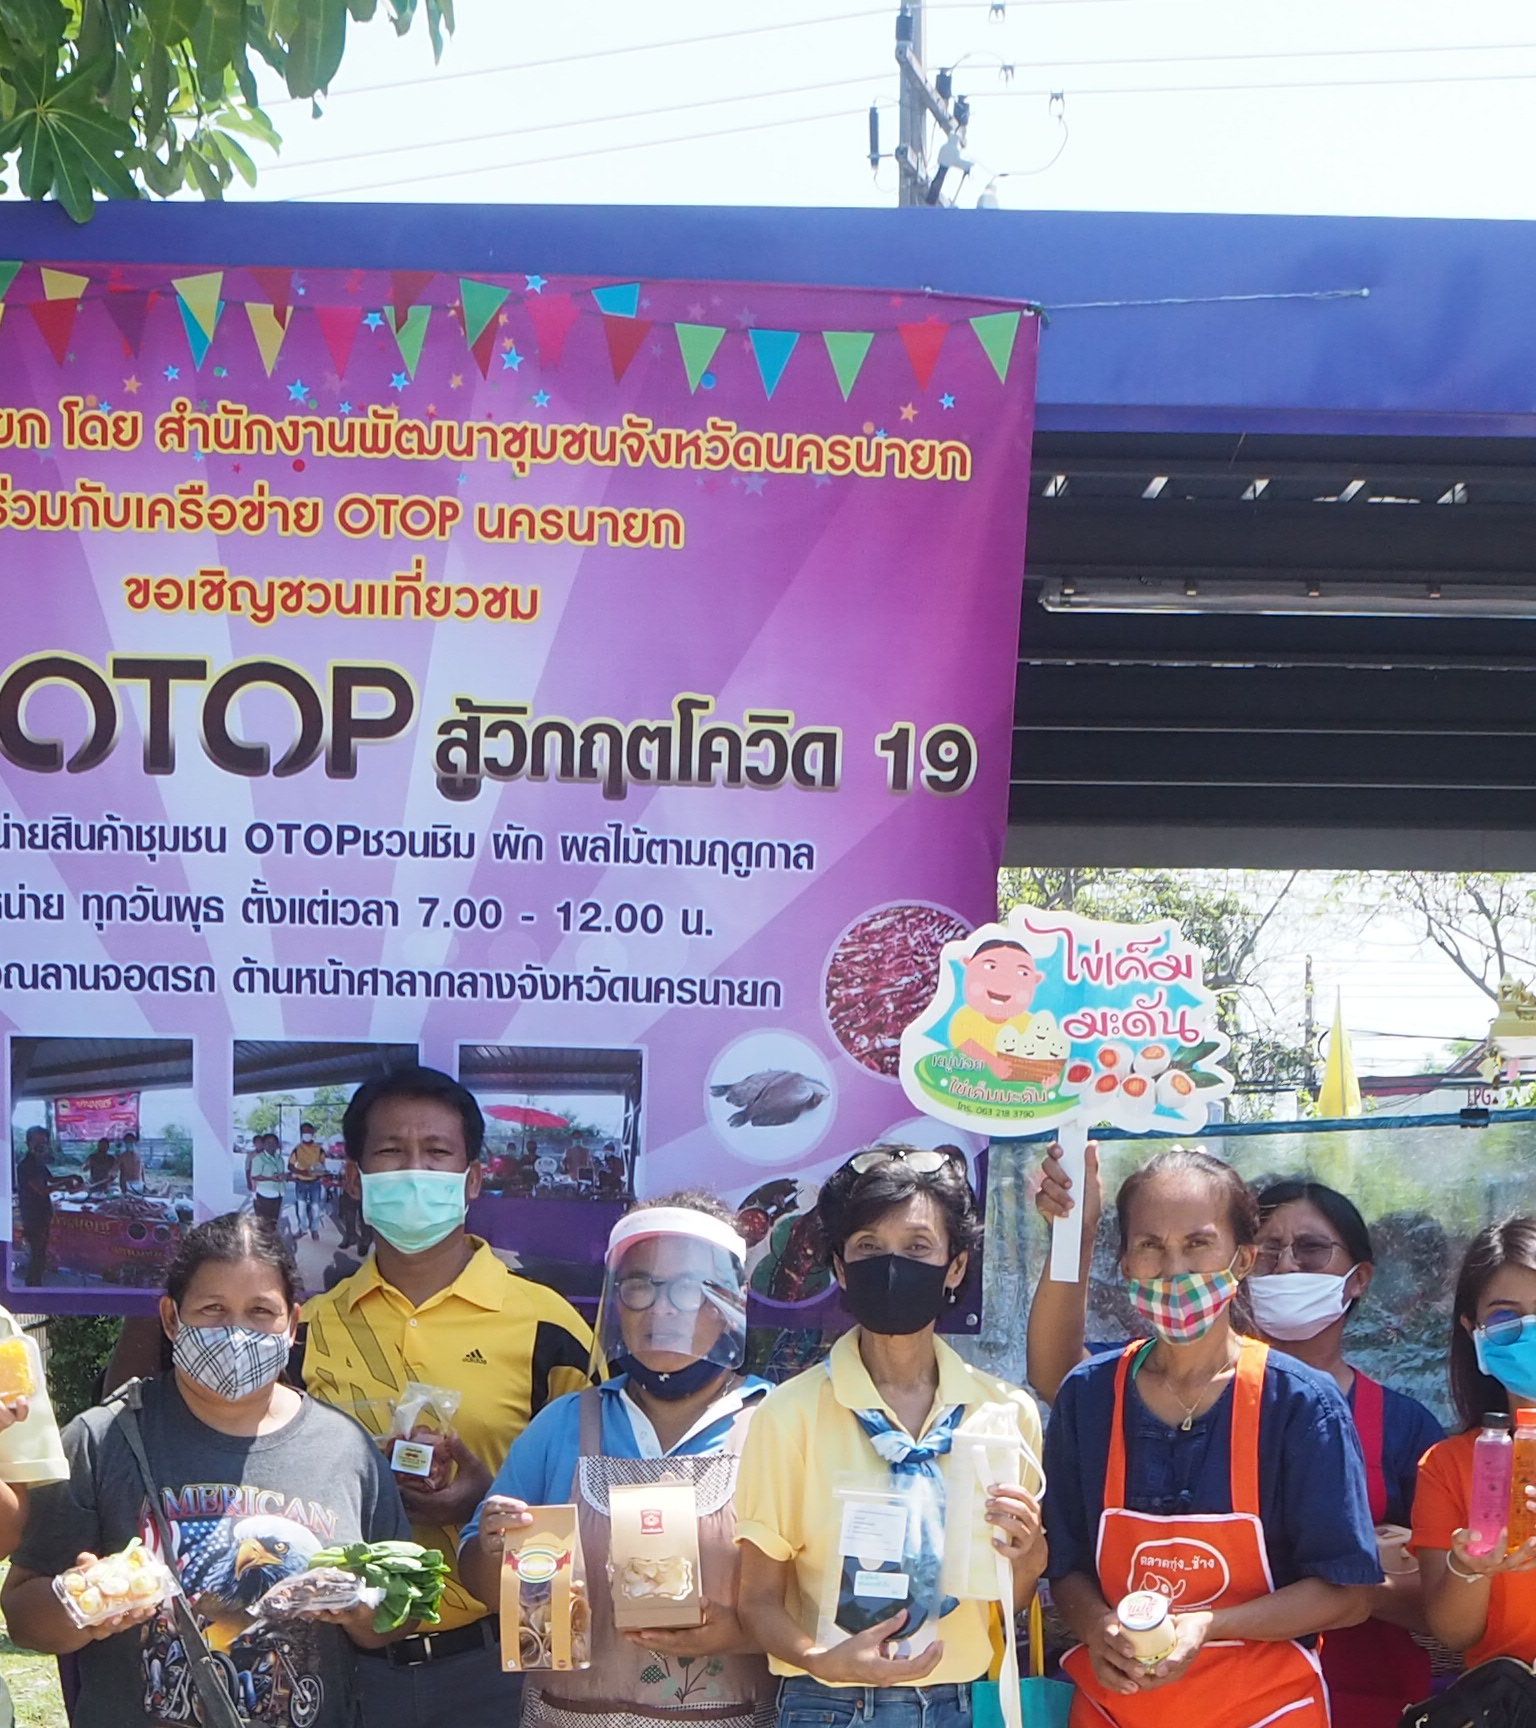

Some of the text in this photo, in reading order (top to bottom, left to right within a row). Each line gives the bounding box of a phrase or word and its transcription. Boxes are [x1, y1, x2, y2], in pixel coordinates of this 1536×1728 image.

[61, 400, 140, 451] โดย
[155, 400, 972, 481] สำนักงานพัฒนาชุมชนจังหวัดนครนายก
[336, 495, 461, 541] OTOP
[475, 504, 685, 549] นครนายก
[433, 694, 840, 803] สู้วิกฤตโควิด
[875, 723, 978, 796] 19
[493, 825, 544, 862] ผัก
[559, 823, 815, 877] ผลไม้ตามฤดูกาล
[81, 886, 225, 932] ทุกวันพุธ
[240, 879, 399, 928] ตั้งแต่เวลา
[418, 896, 503, 930] 7.00
[555, 901, 665, 935] 12.00
[679, 908, 715, 937] น.
[1024, 917, 1194, 985] ไข่เค็ม
[232, 957, 782, 1009] ด้านหน้าศาลากลางจังหวัดนครนายก
[1063, 991, 1200, 1043] มะดัน
